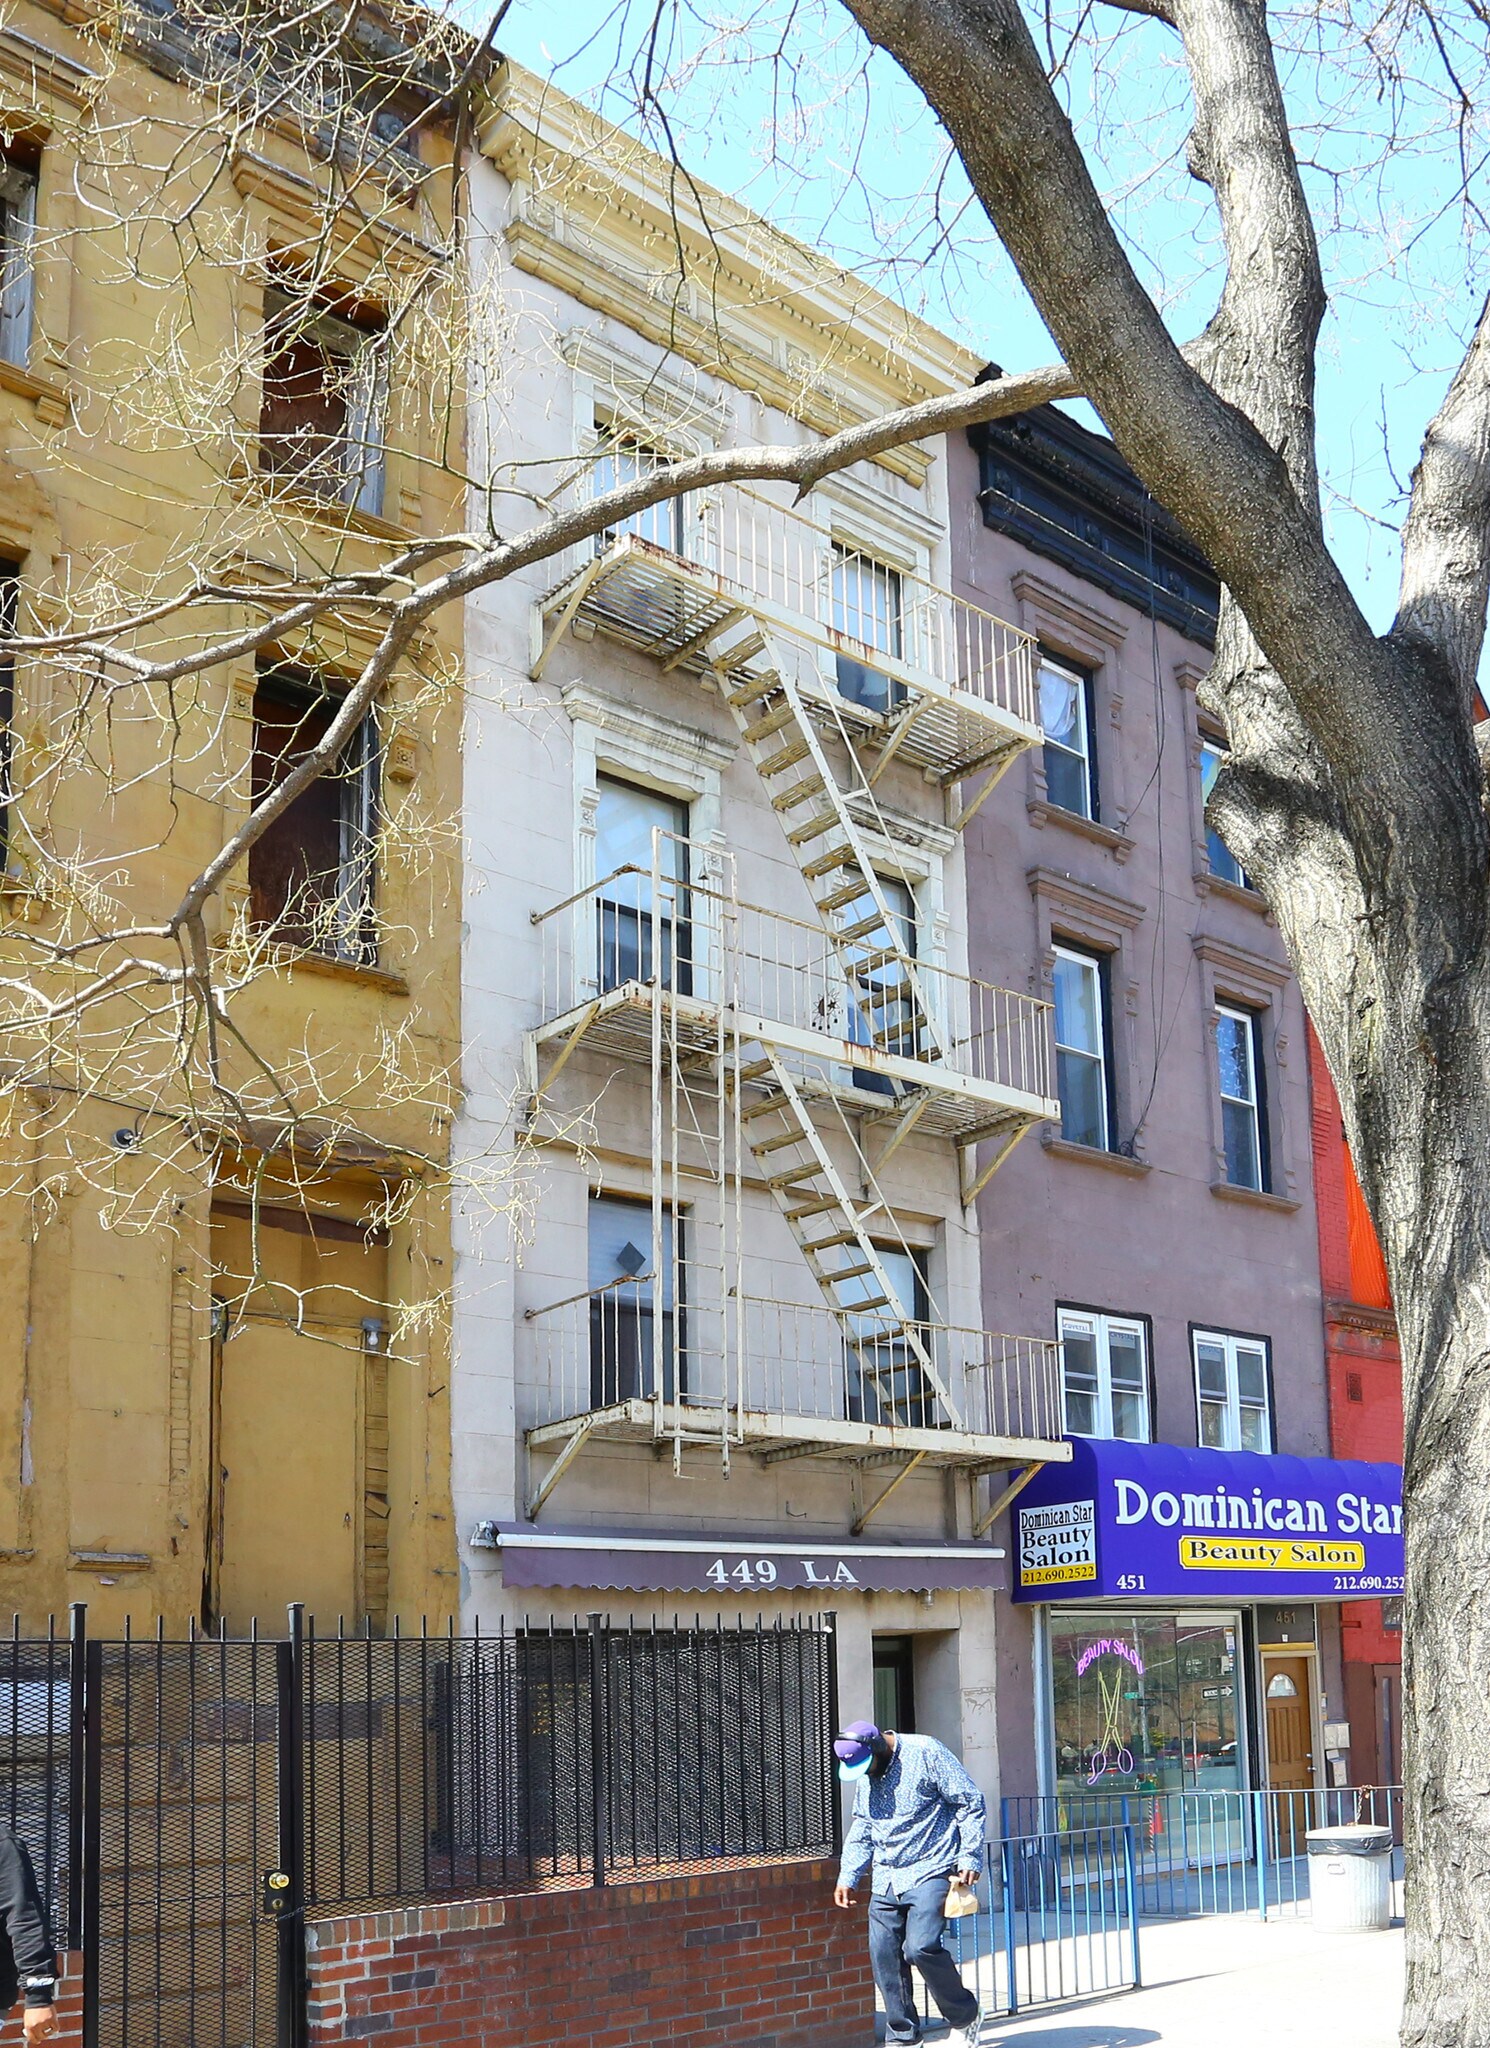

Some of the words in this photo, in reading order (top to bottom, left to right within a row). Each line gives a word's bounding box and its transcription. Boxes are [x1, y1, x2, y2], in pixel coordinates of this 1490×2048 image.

[1021, 1508, 1071, 1529] Dominican
[1073, 1504, 1093, 1522] Star
[1114, 1479, 1328, 1532] Dominican
[1336, 1493, 1403, 1535] Star
[1022, 1527, 1092, 1549] Beauty
[1022, 1547, 1091, 1568] Salon
[1190, 1541, 1281, 1566] Beauty
[1291, 1544, 1357, 1563] Salon
[705, 1558, 777, 1584] 449
[800, 1560, 859, 1583] LA
[1023, 1566, 1094, 1583] 212.690.2522
[1116, 1574, 1146, 1590] 451
[1333, 1576, 1404, 1590] 212.690.252
[1275, 1611, 1297, 1625] 451
[1078, 1639, 1112, 1676] BEAUTY
[1113, 1639, 1143, 1675] SALON
